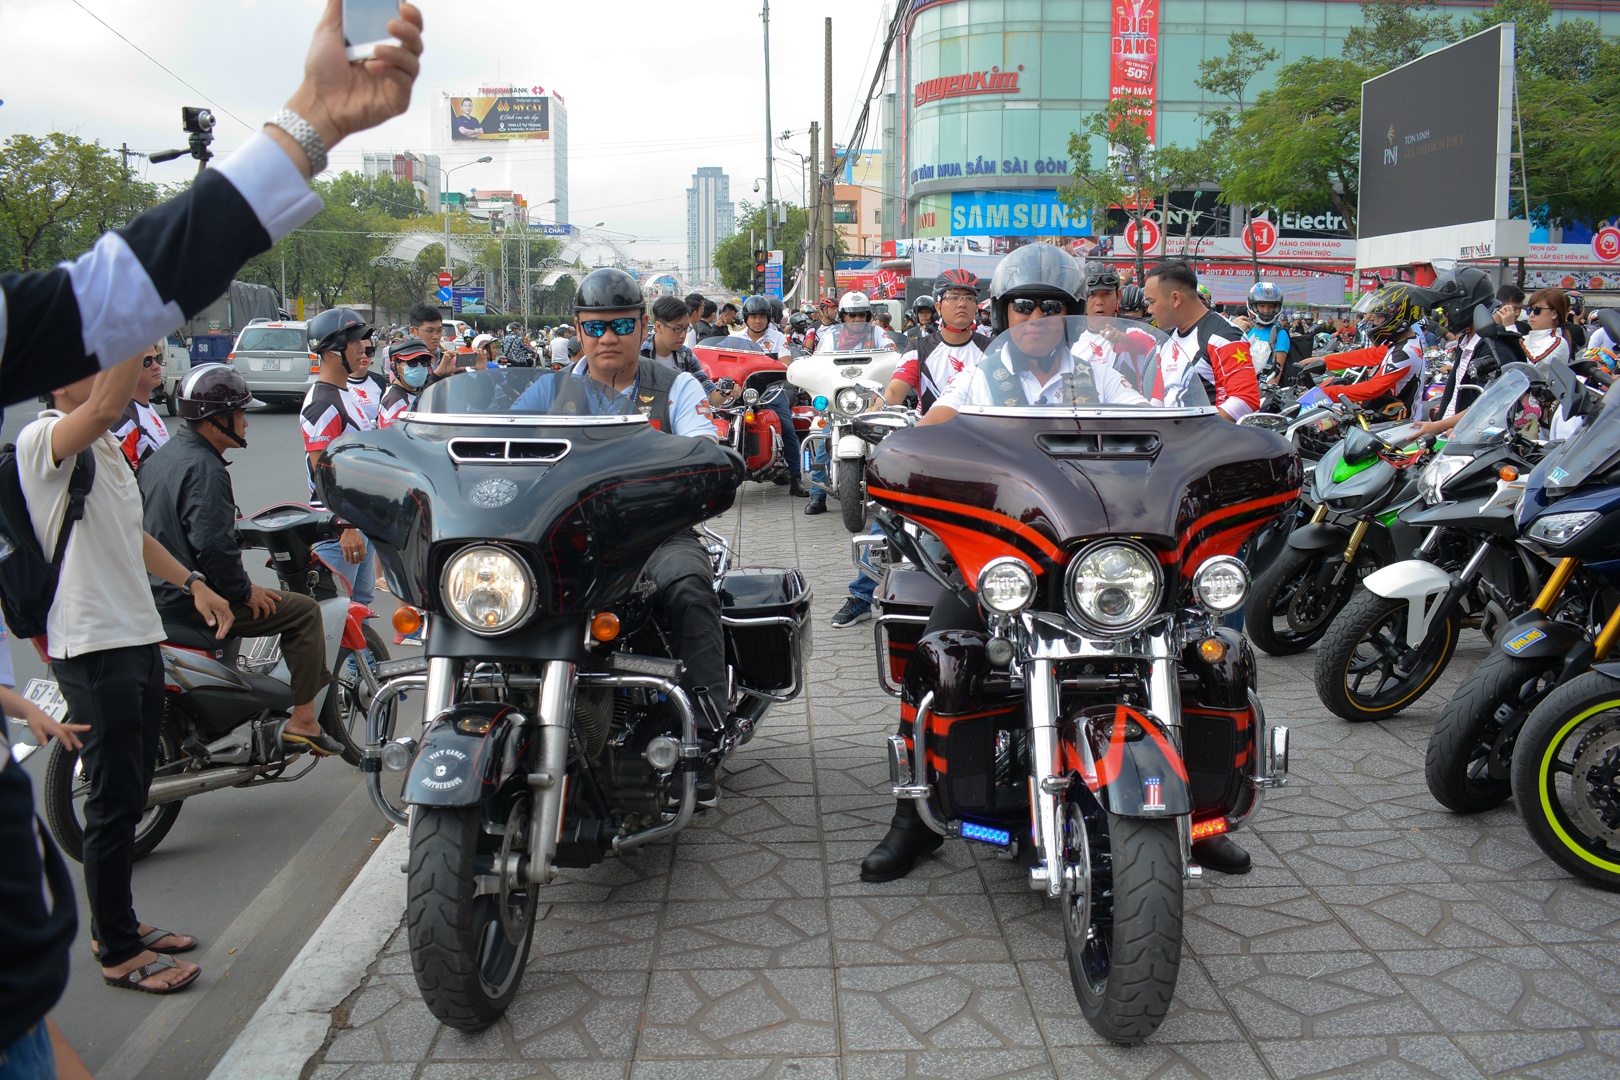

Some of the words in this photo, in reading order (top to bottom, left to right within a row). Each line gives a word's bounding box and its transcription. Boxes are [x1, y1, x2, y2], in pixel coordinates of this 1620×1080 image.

[1119, 15, 1149, 35] BIG
[1112, 36, 1157, 56] BANG
[1383, 146, 1398, 166] PNJ
[938, 162, 962, 177] MUA
[1002, 156, 1028, 174] SÀI
[1034, 156, 1067, 174] GÒN
[1266, 269, 1279, 277] KIM
[198, 344, 208, 352] 58
[429, 749, 445, 760] VIET
[421, 776, 463, 790] BROTHERHOOD
